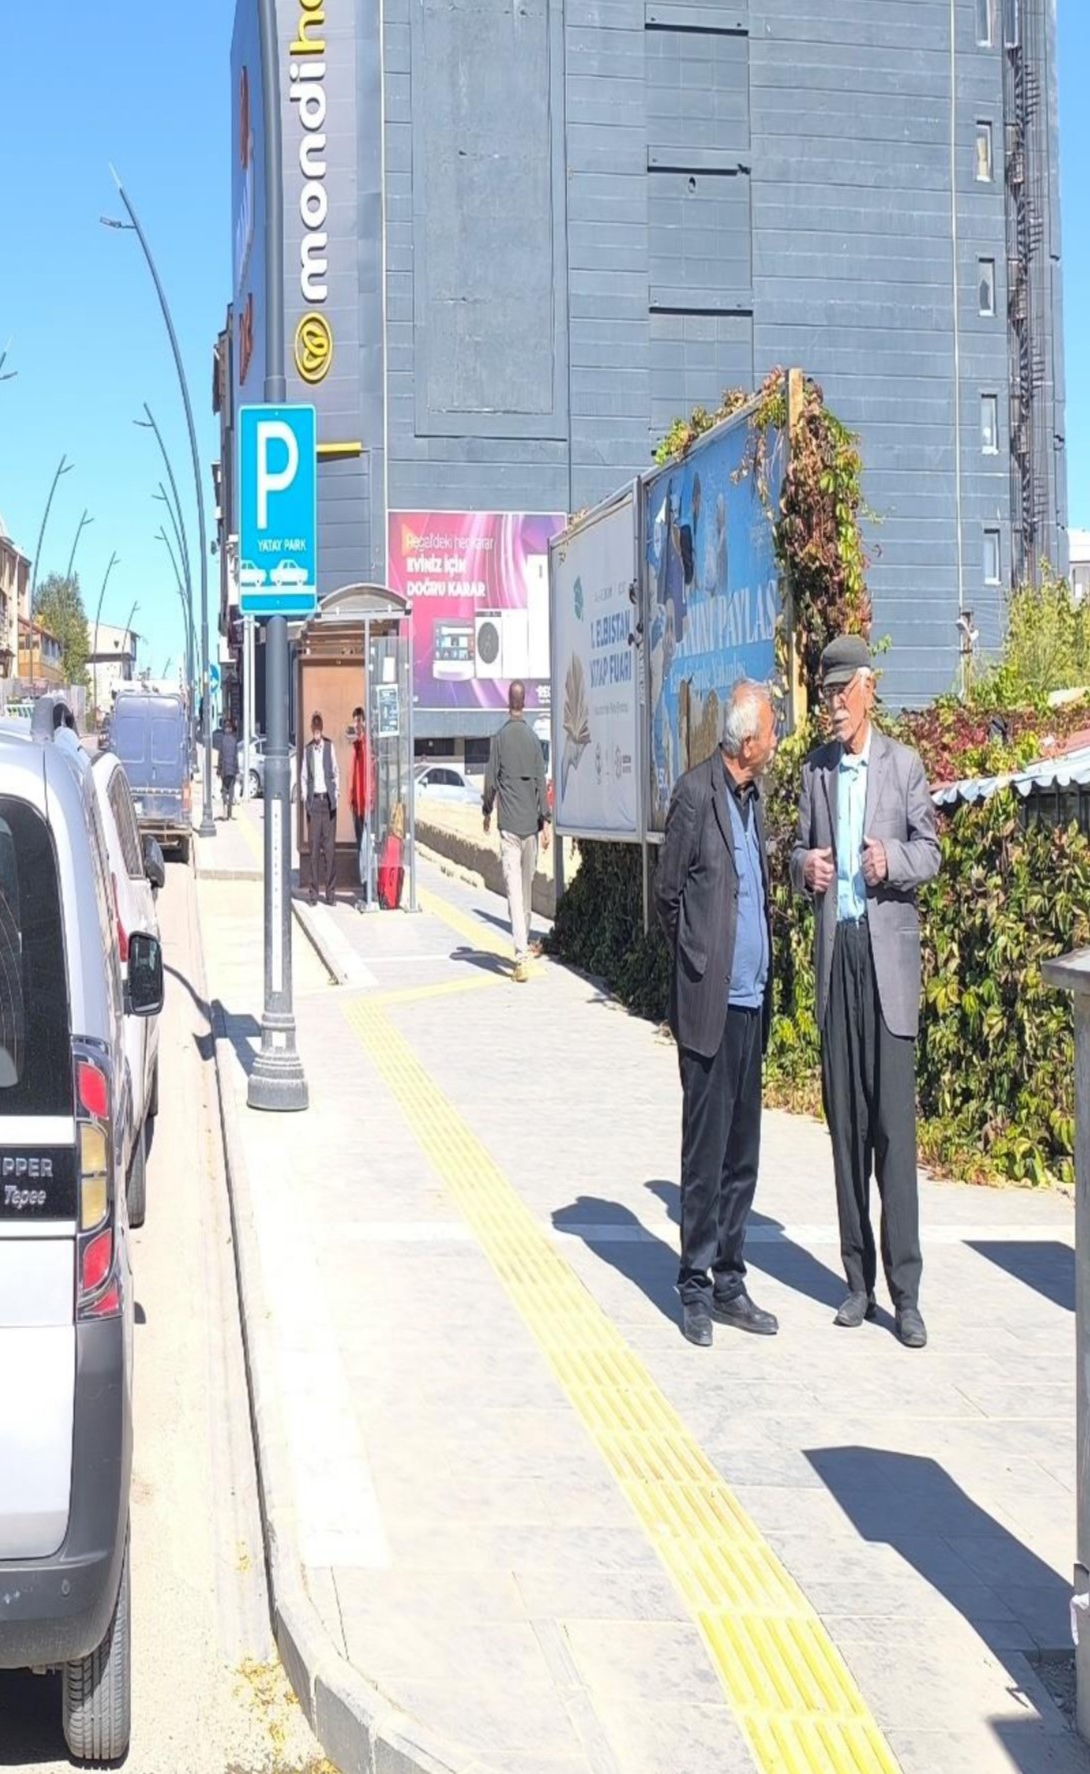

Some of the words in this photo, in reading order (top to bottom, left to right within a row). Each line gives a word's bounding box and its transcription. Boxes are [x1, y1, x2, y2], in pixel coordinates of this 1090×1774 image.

[289, 0, 328, 304] mondih
[257, 420, 299, 530] P
[258, 539, 281, 552] YATAY
[284, 539, 306, 551] PARK
[407, 577, 446, 597] DOĞRU
[448, 581, 487, 597] KARAR
[4, 1185, 46, 1210] Tepee
